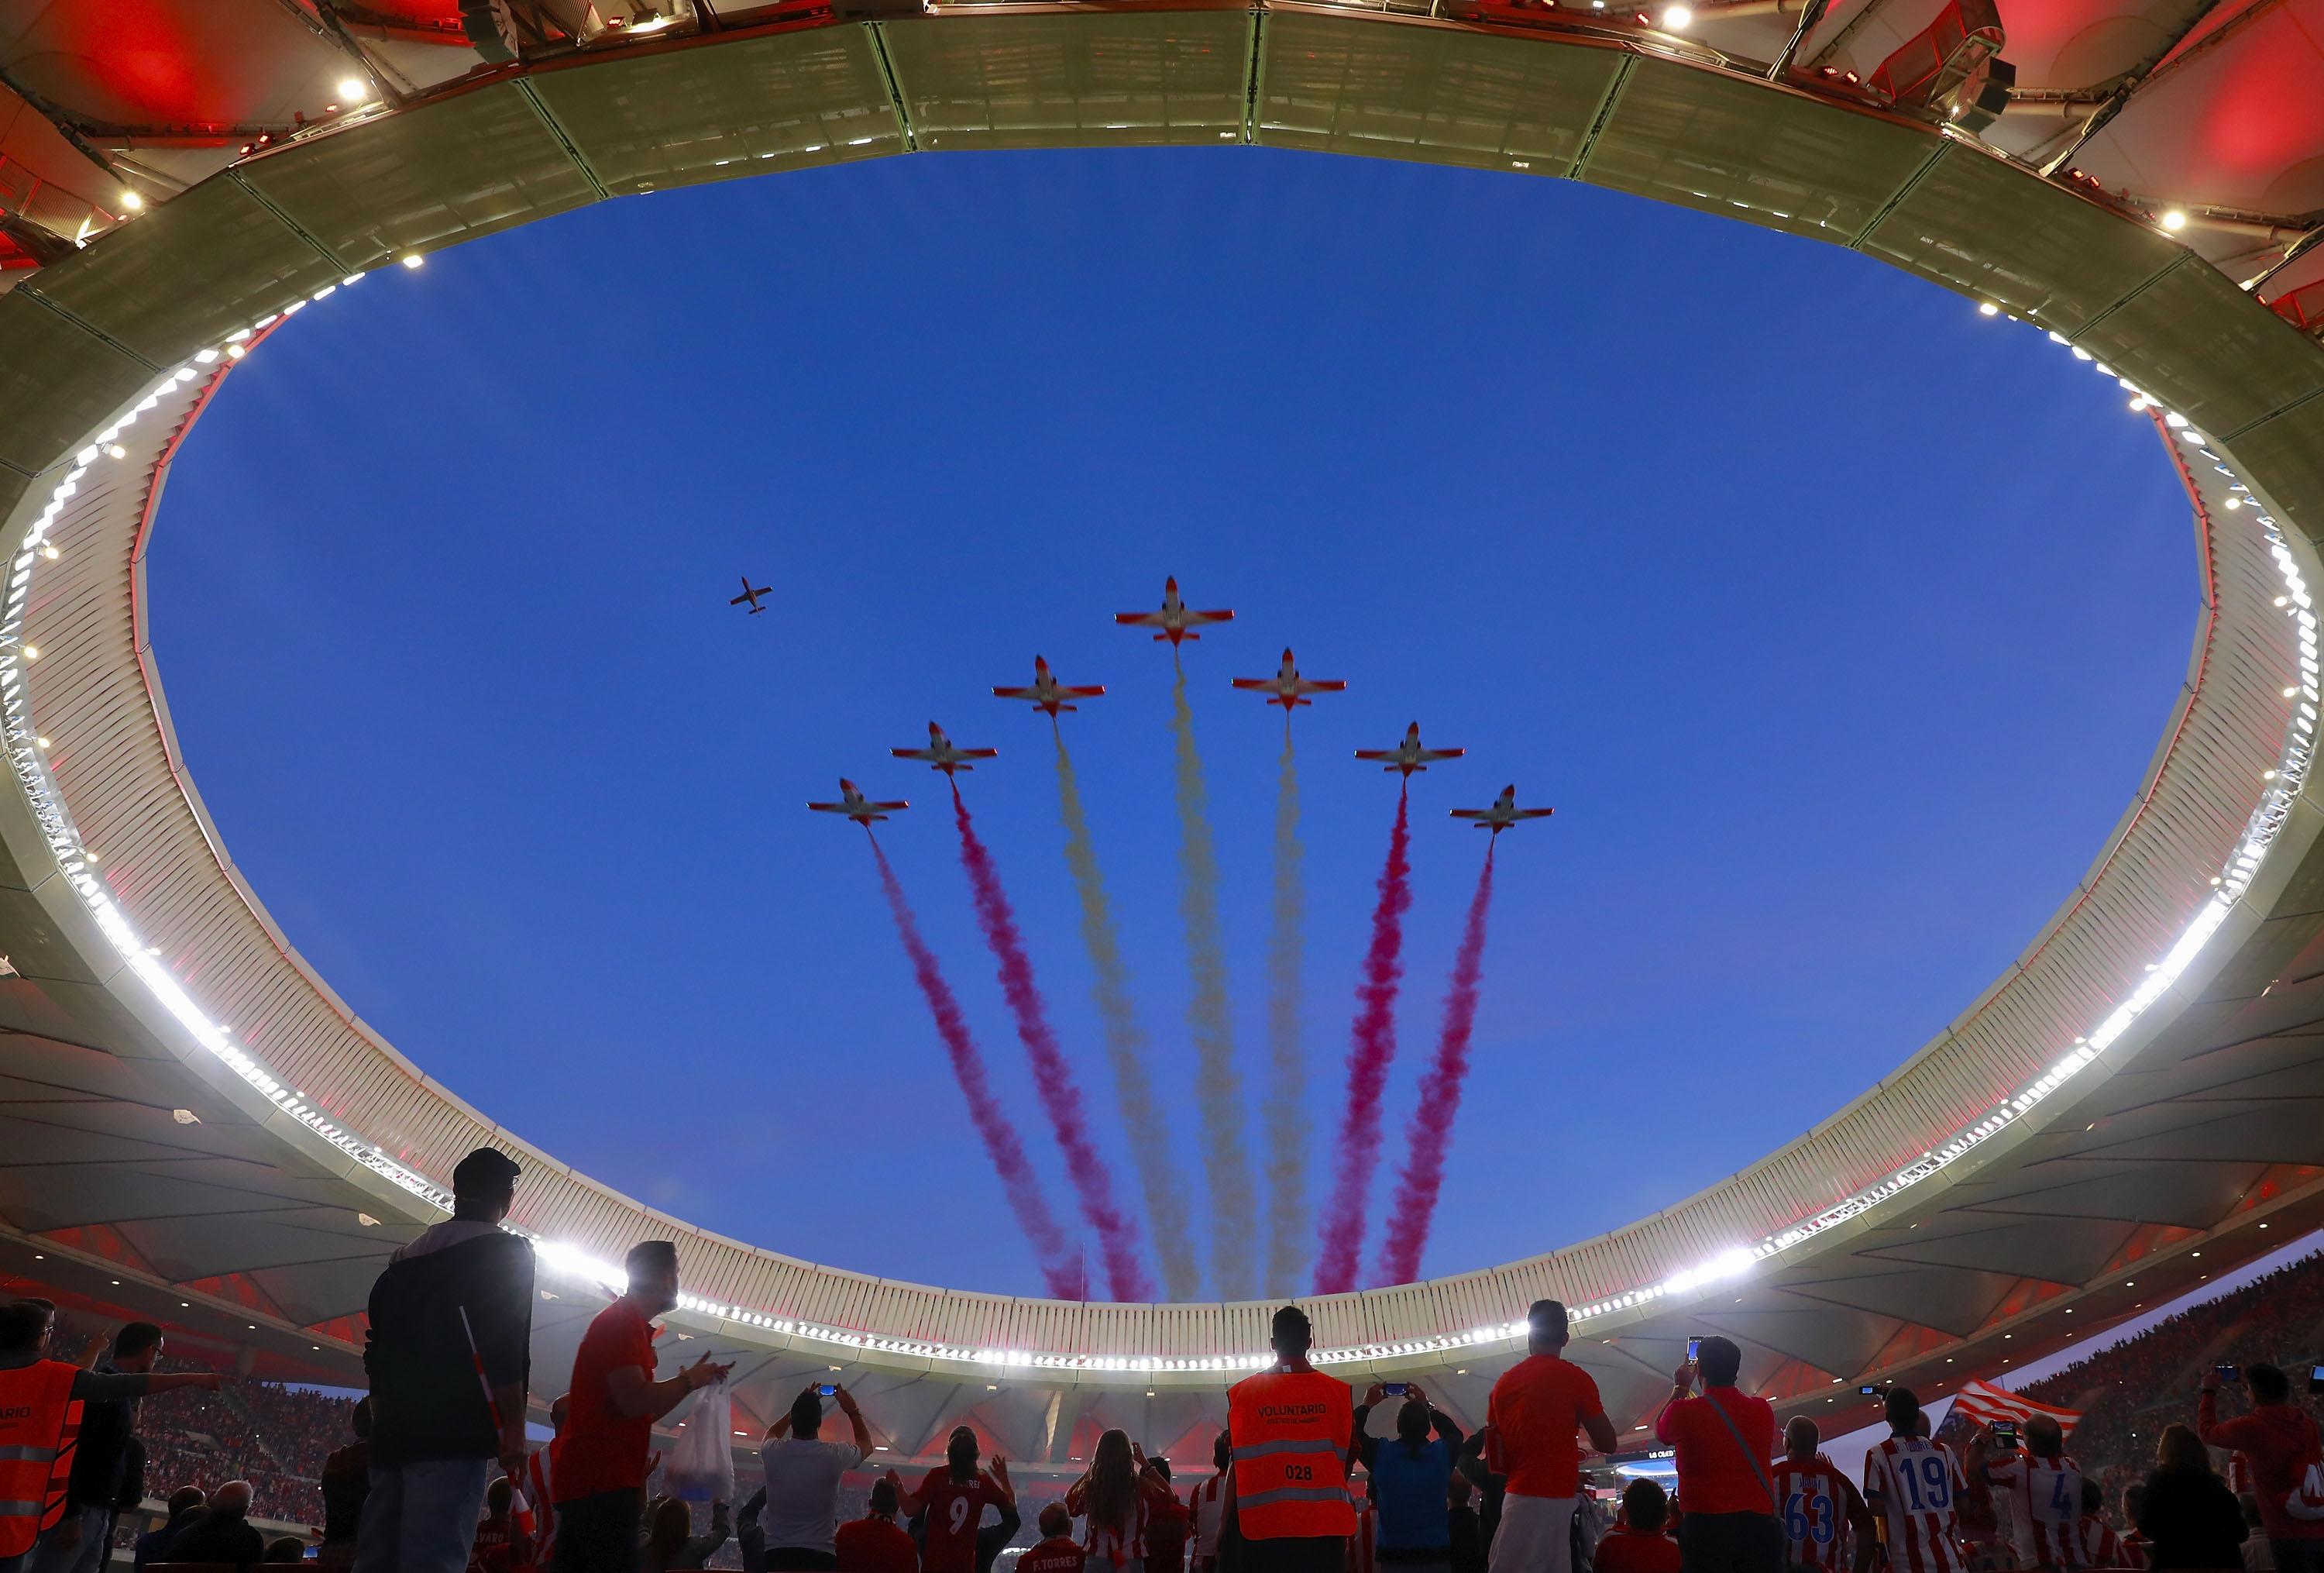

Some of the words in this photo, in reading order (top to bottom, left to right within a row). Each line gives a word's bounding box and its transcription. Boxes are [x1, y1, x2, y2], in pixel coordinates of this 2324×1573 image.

[1258, 1403, 1326, 1418] VOLUNTARIO
[1285, 1465, 1312, 1481] 028
[1658, 1450, 1674, 1458] OLED
[1899, 1457, 1949, 1509] 19
[2051, 1473, 2071, 1519] 4
[949, 1496, 968, 1535] 9
[1785, 1493, 1834, 1543] 63
